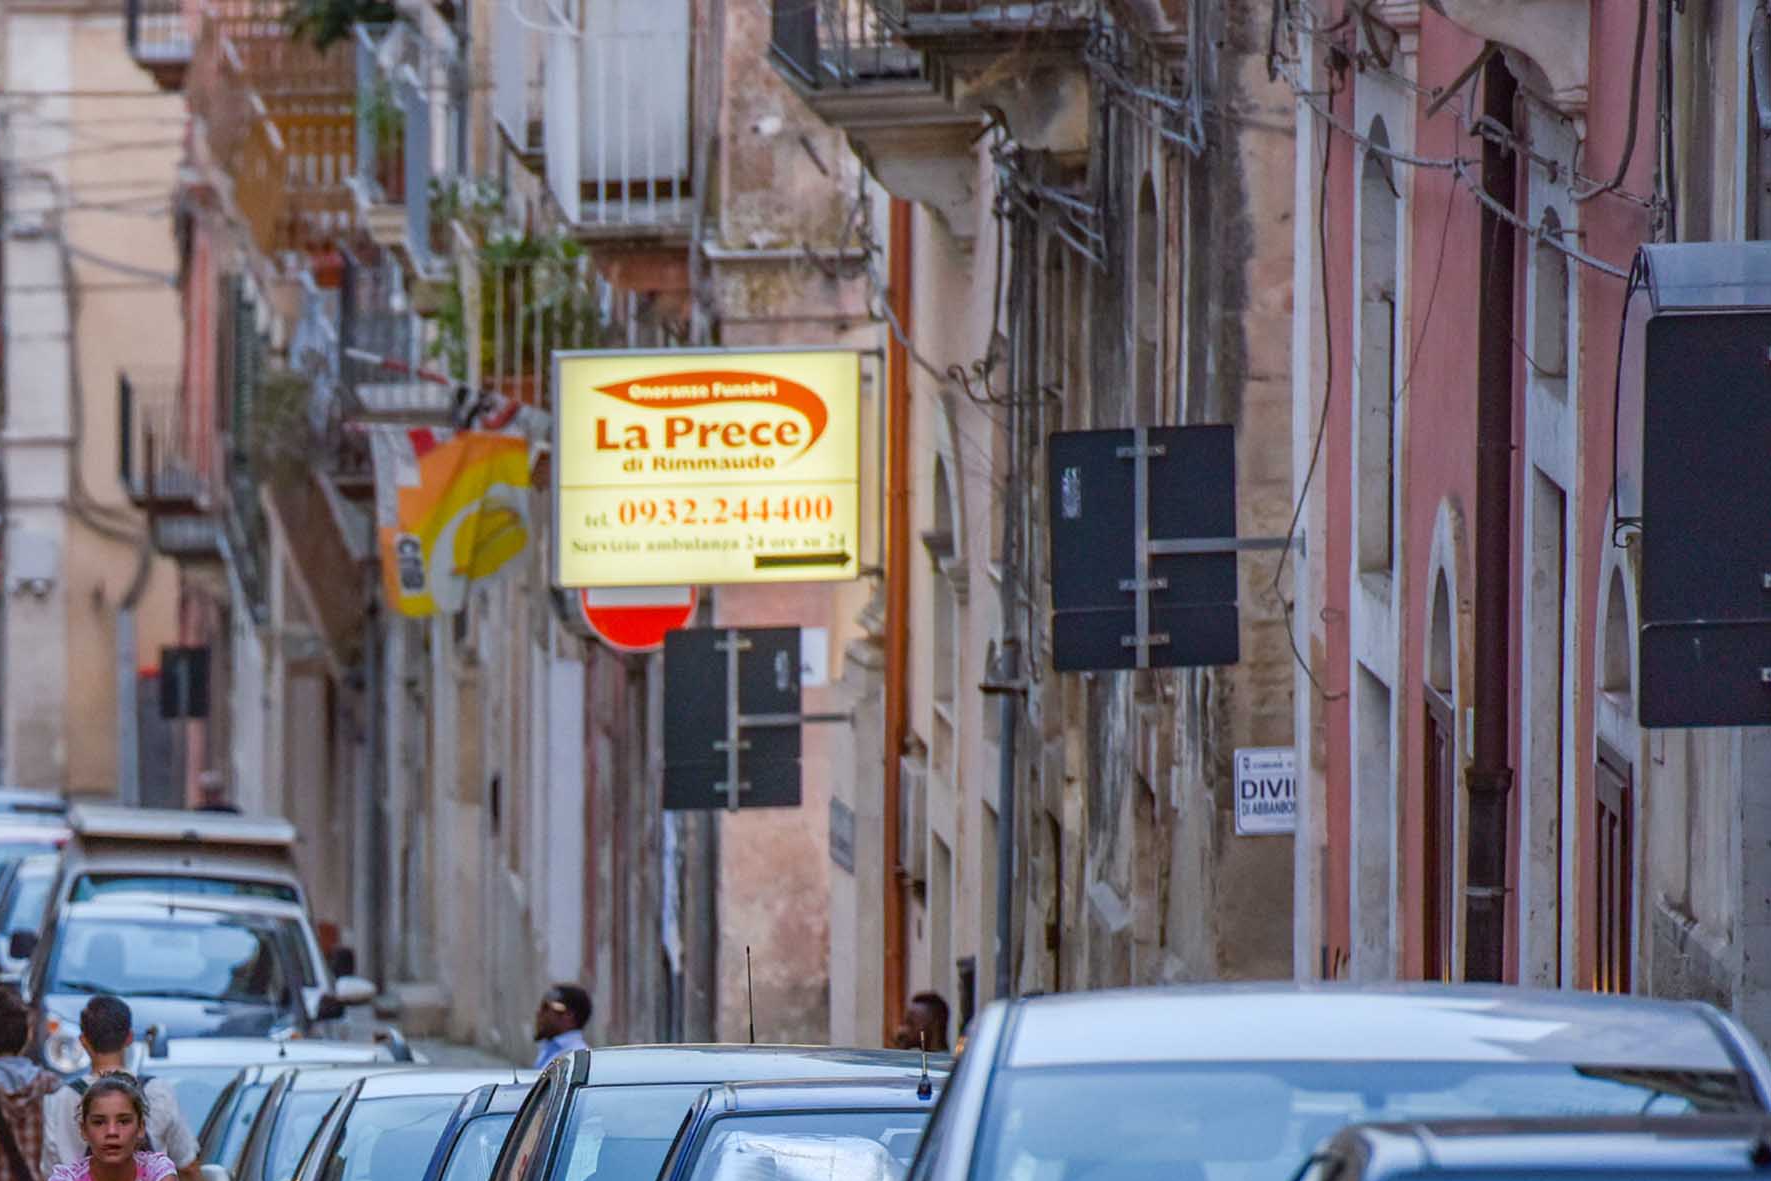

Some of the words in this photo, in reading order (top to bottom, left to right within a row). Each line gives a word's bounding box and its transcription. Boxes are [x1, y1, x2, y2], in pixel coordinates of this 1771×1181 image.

[596, 417, 649, 450] La
[665, 416, 801, 449] Prece
[622, 455, 643, 473] di
[652, 453, 775, 471] Rimmaudo
[584, 511, 611, 528] tel.
[618, 495, 834, 525] 0932.244400
[571, 538, 641, 554] Servizio
[646, 534, 740, 552] ambulanza
[746, 534, 766, 549] 24
[827, 532, 846, 548] 24
